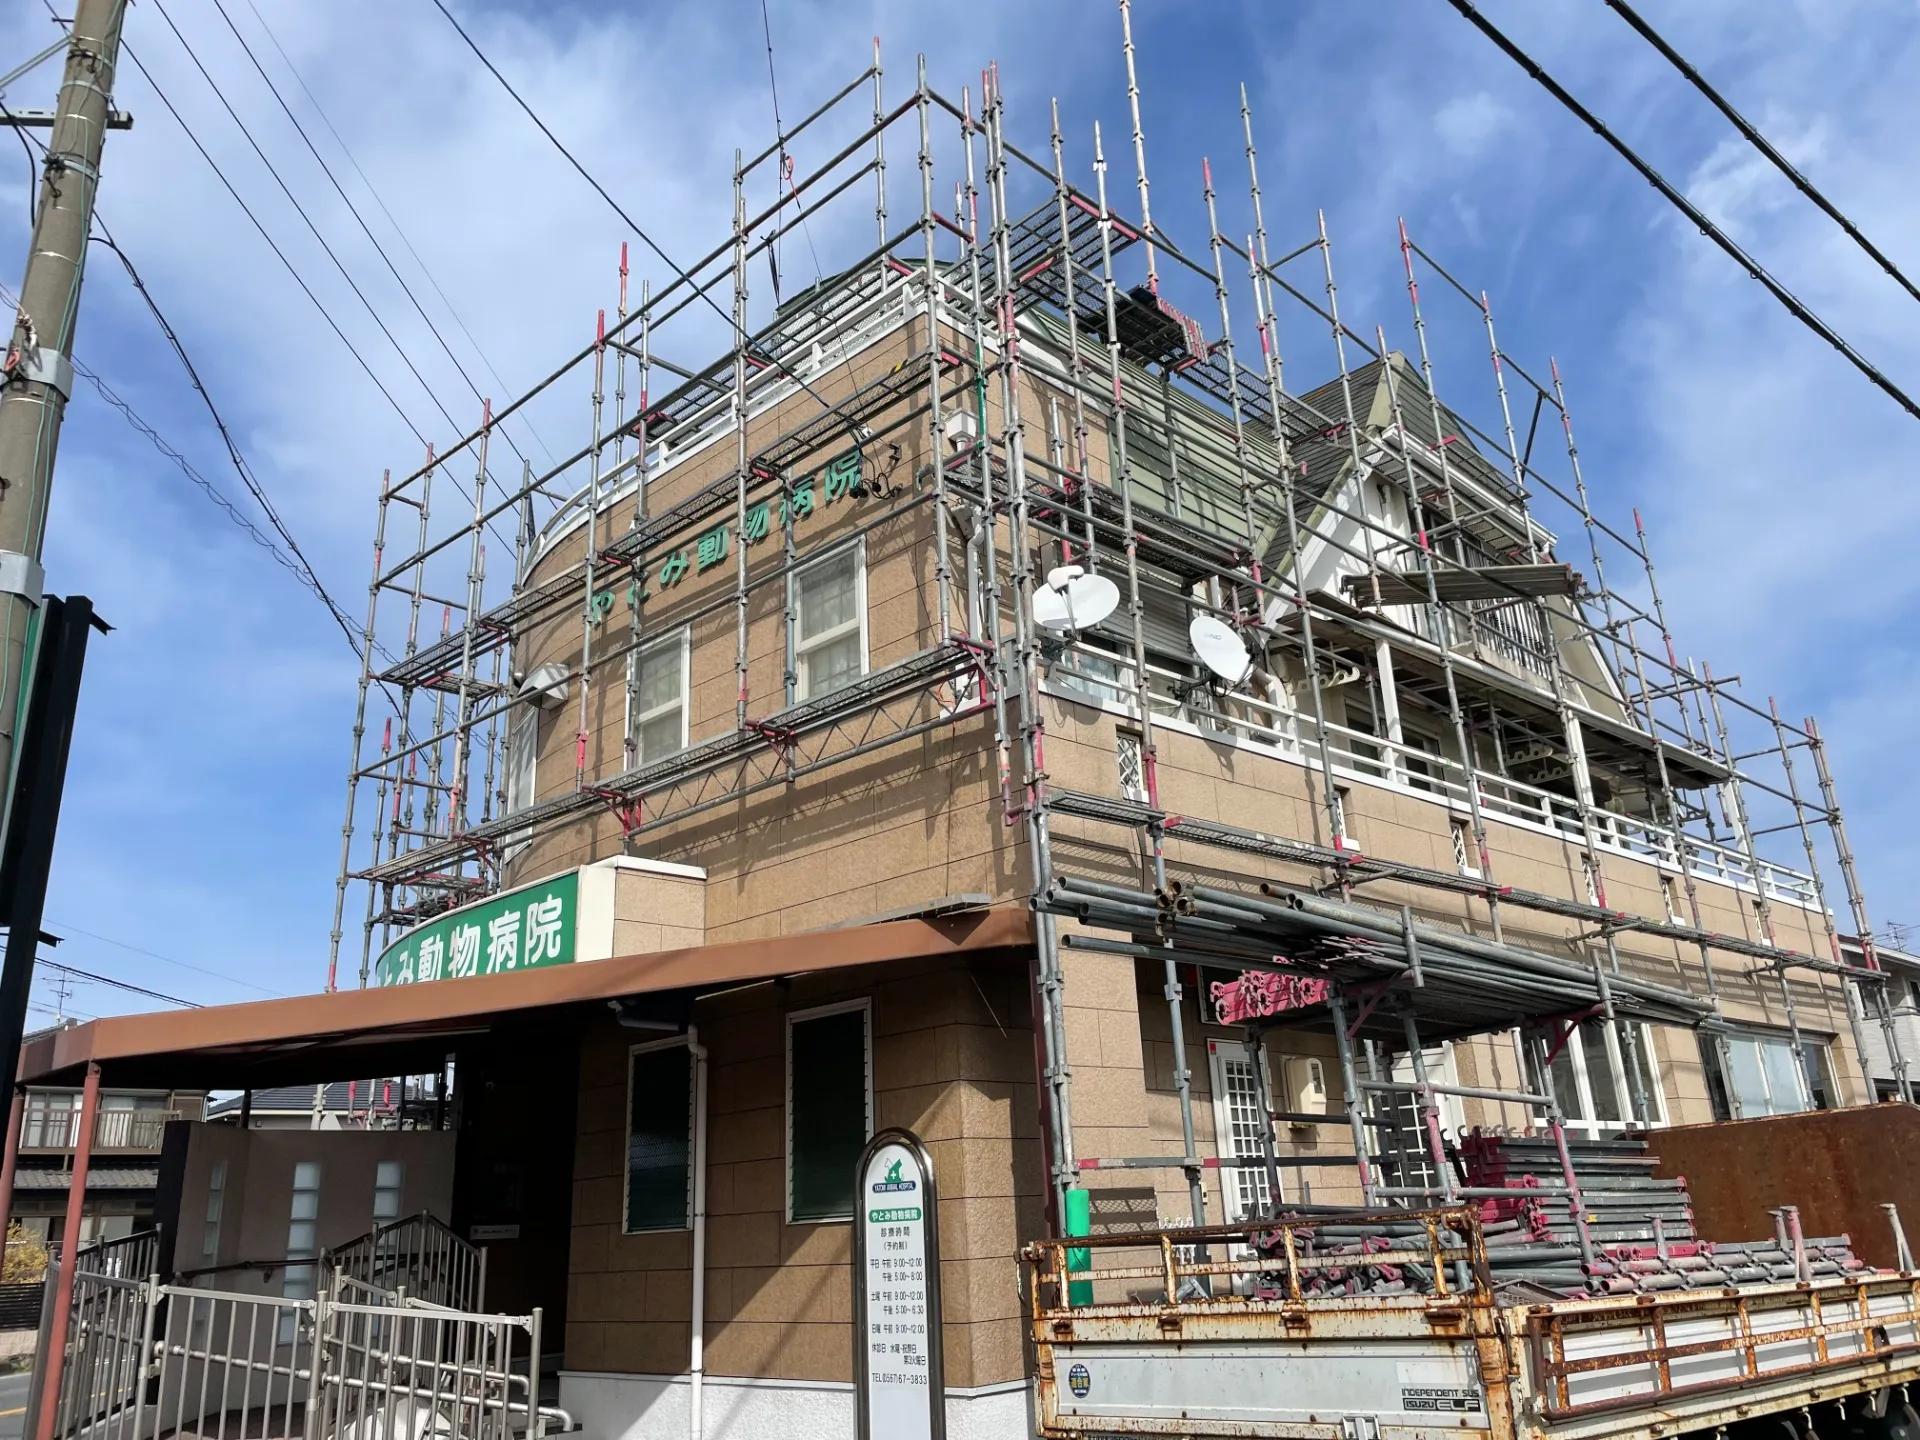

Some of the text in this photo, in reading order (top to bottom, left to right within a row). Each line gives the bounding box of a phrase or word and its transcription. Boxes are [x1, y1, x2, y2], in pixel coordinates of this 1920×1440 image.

[871, 1208, 918, 1221] やとみ動物病院
[880, 1226, 910, 1237] 診療時間
[884, 1241, 908, 1251] (予約制)
[870, 1258, 880, 1269] 平日
[882, 1258, 892, 1268] 午前
[882, 1271, 892, 1281] 午後
[871, 1291, 881, 1301] 土曜
[883, 1291, 893, 1301] 午前
[883, 1305, 893, 1315] 午後
[872, 1323, 881, 1334] 日曜
[883, 1324, 893, 1334] 午前
[1401, 1388, 1480, 1397] INDEPENDENT SUS
[1406, 1399, 1479, 1411] ISUZU ELF
